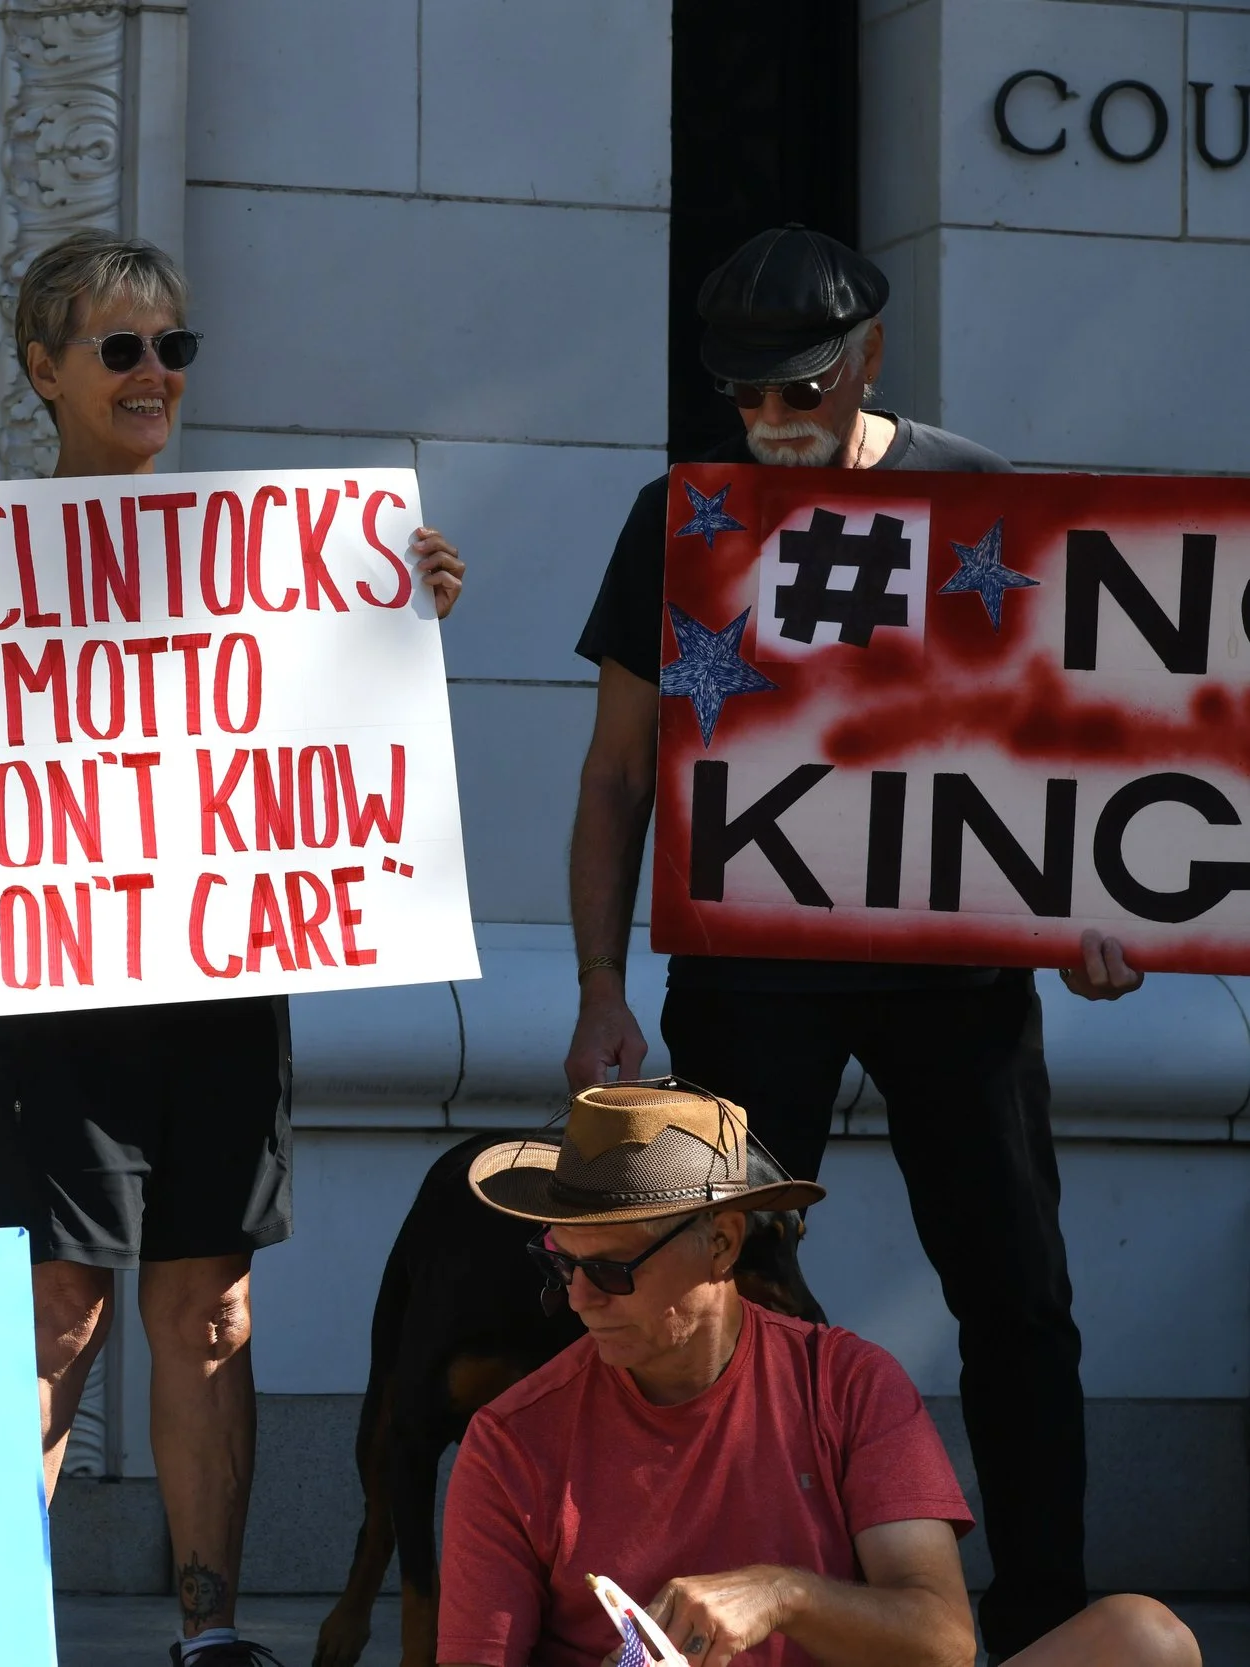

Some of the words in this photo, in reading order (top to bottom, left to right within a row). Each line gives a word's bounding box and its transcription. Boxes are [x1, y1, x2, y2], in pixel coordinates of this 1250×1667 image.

[1063, 529, 1250, 675] N
[3, 633, 262, 745] MOTTO
[197, 745, 405, 855] KNOW
